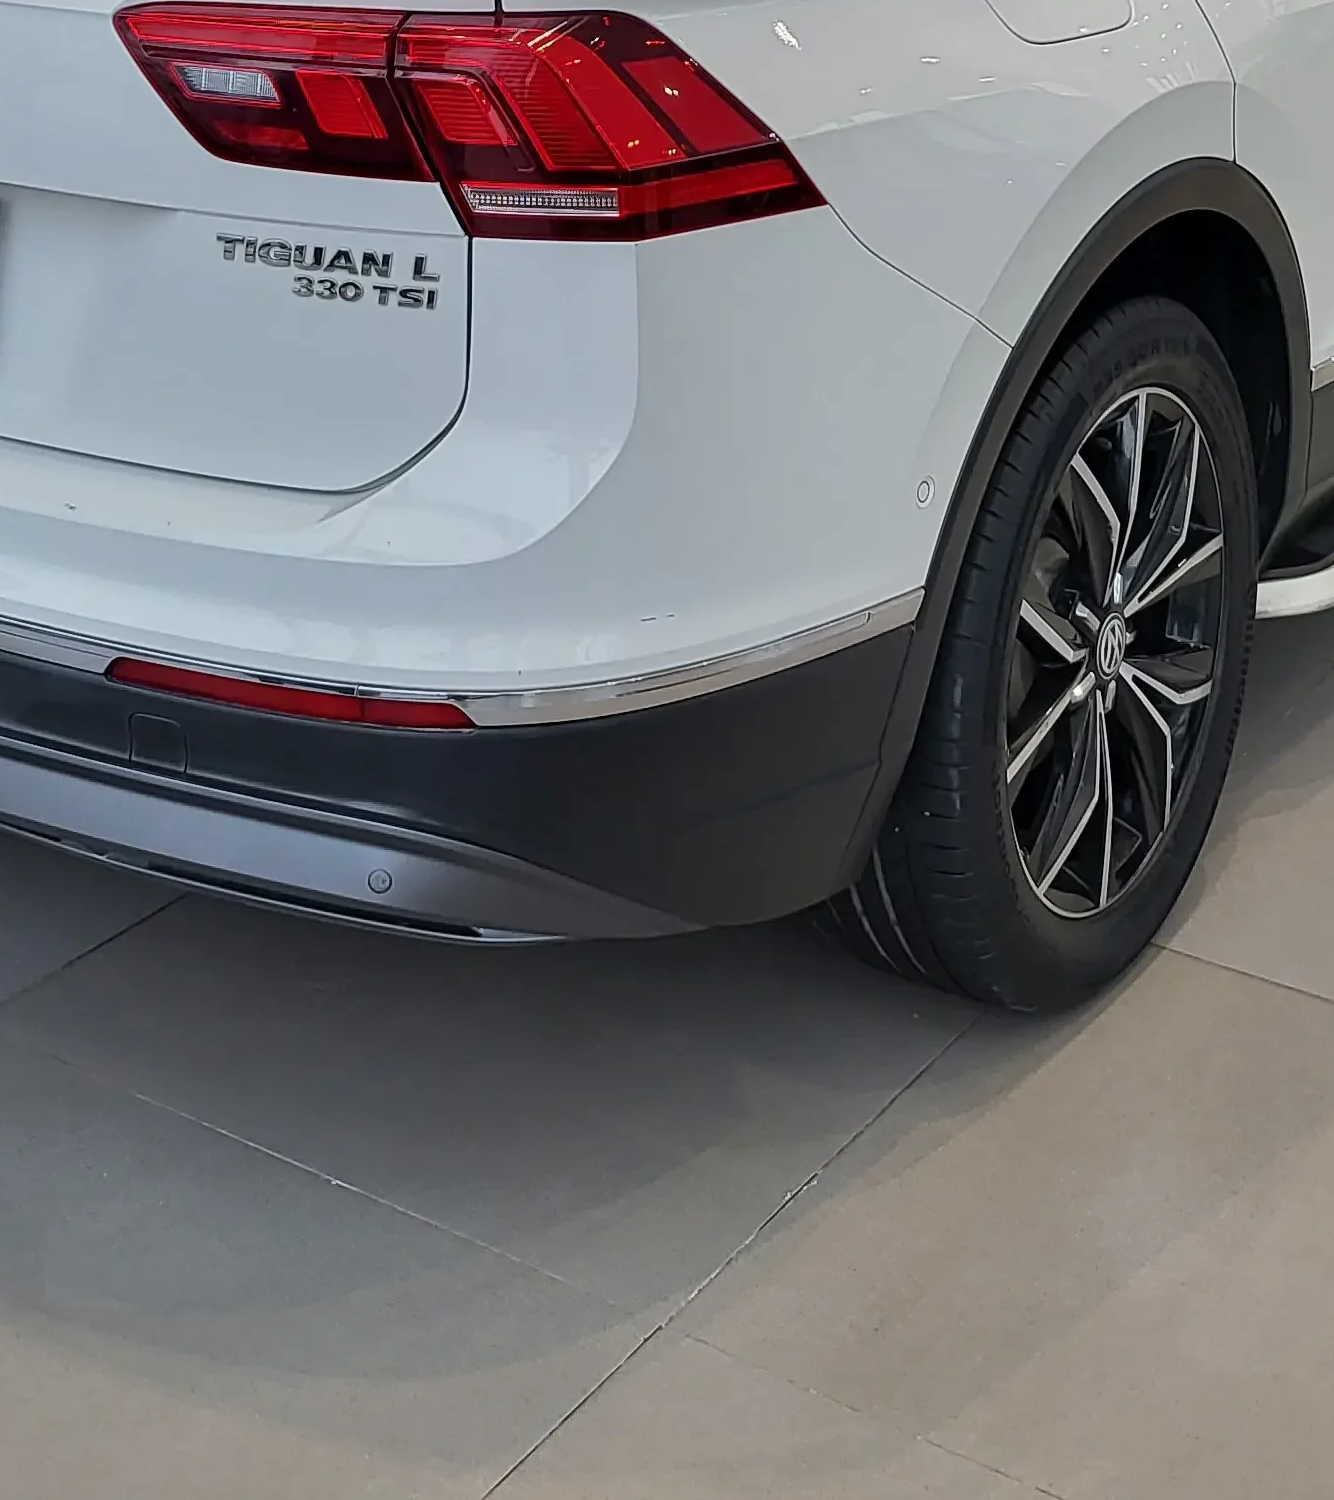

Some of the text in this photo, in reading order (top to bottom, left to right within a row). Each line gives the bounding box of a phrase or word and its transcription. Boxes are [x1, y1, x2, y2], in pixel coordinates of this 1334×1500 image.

[215, 231, 441, 283] TIGUAN L
[291, 273, 439, 311] 330 TSI
